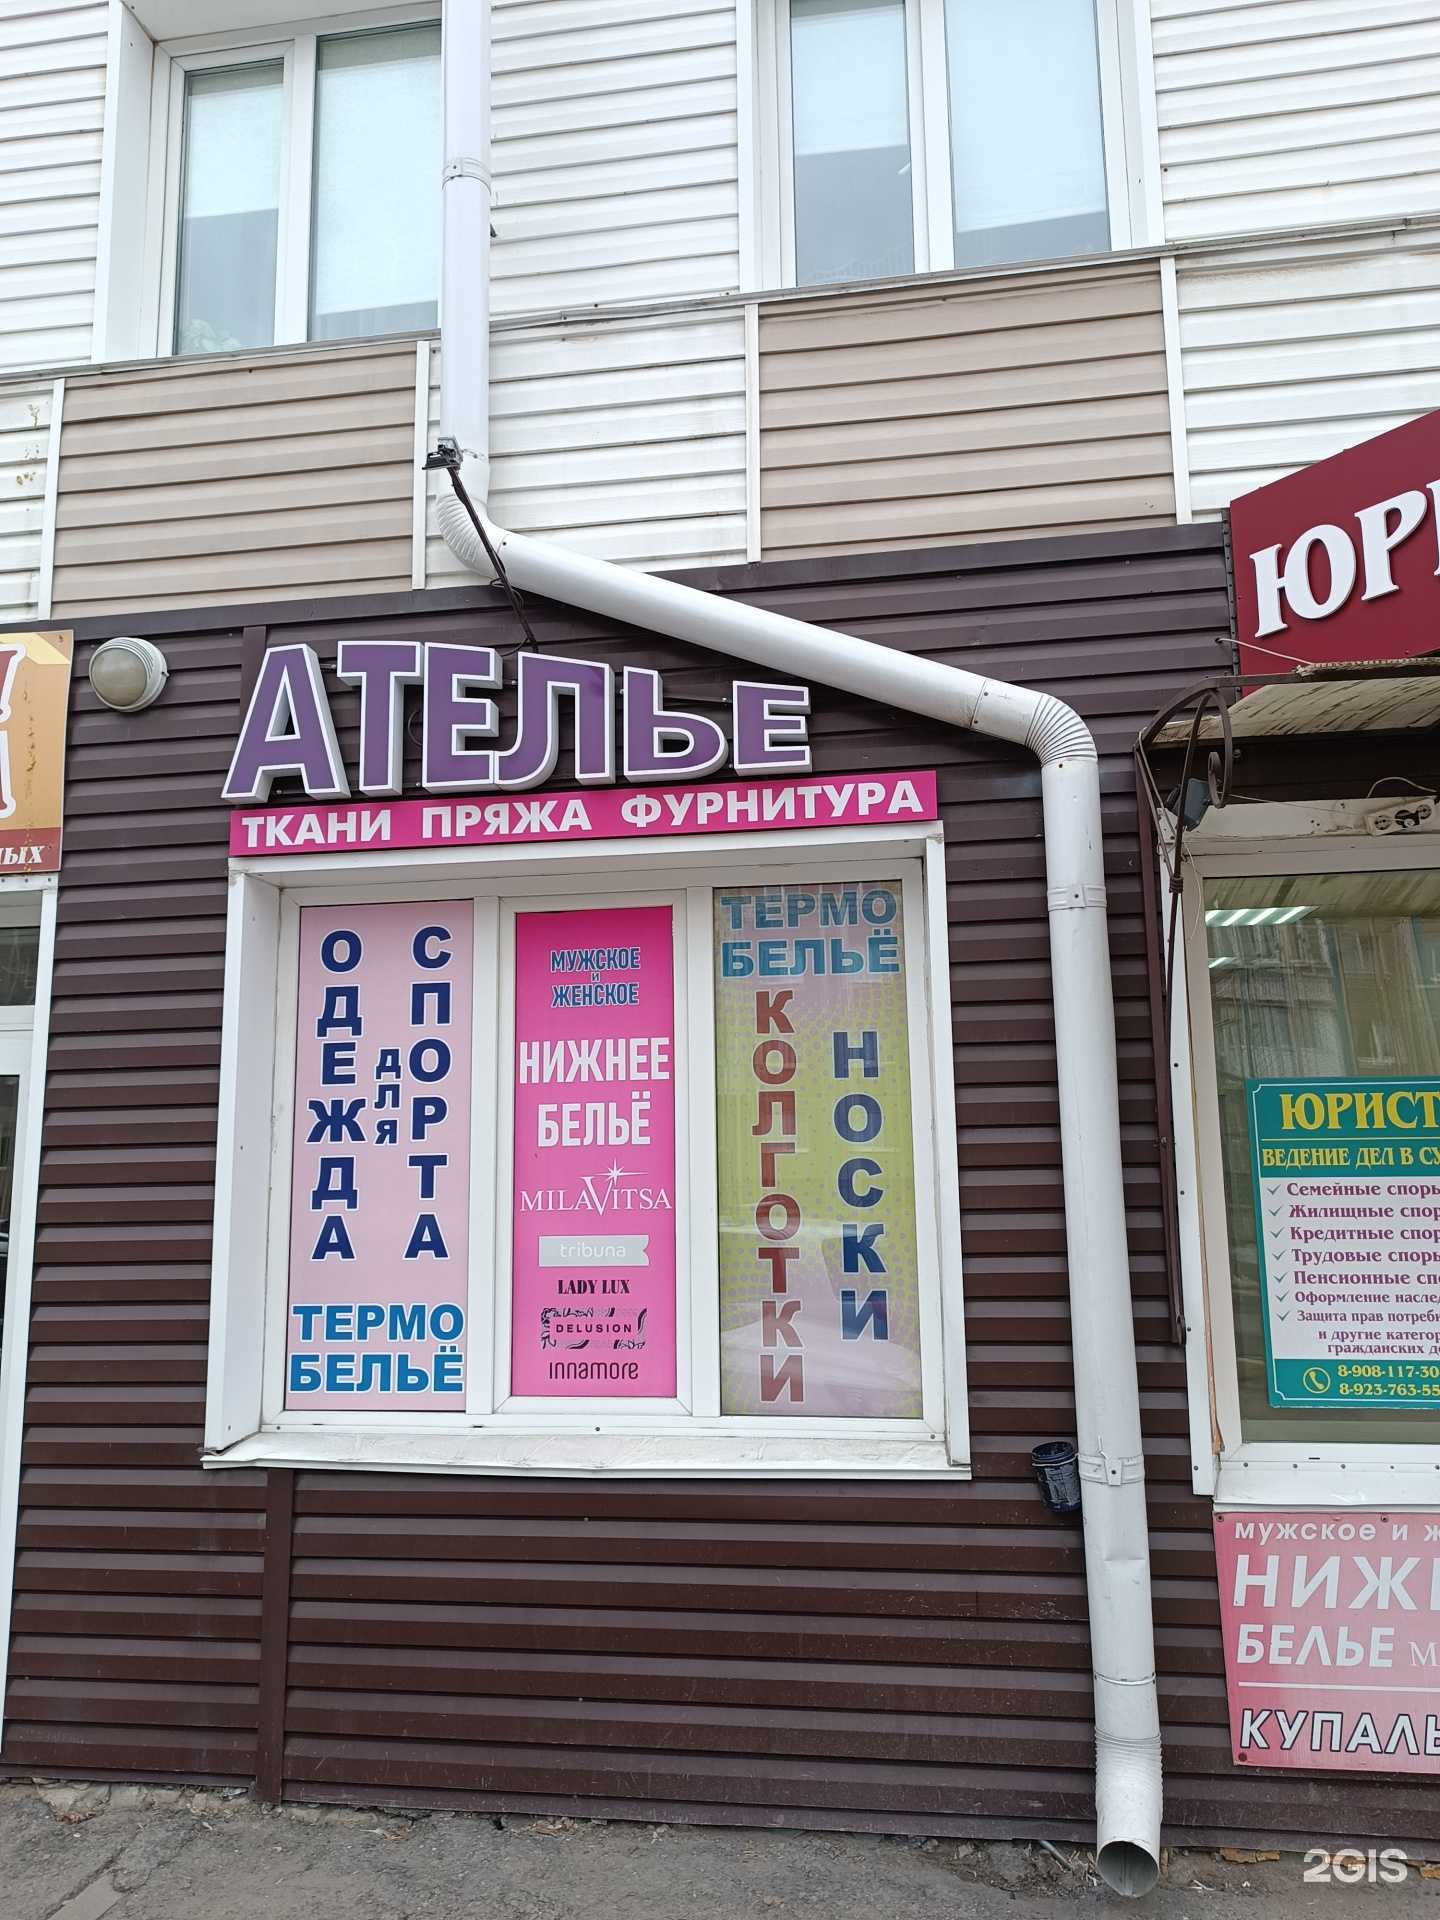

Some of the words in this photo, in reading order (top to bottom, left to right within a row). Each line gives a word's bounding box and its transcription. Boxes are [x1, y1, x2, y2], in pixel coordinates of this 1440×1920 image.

[1249, 479, 1440, 637] ЮР
[221, 640, 812, 804] АТЕЛЬЕ
[241, 809, 392, 848] ТКАНИ
[421, 798, 592, 840] ПРЯЖА
[620, 780, 924, 829] ФУРНИТУРА
[0, 846, 45, 864] ЫХ
[719, 888, 898, 931] ТЕРМО
[551, 947, 640, 972] МУЖСКОЕ
[719, 928, 901, 979] БЕЛЬЁ
[551, 983, 640, 1008] ЖЕНСКОЕ
[519, 1037, 670, 1084] НИЖНЕЕ
[305, 928, 367, 1262] ОДЕЖДА
[402, 925, 454, 1262] СПОРТА
[538, 1090, 651, 1147] БЕЛЬЁ
[1279, 1091, 1440, 1130] ЮРИСТ
[1262, 1147, 1350, 1170] ВЕДЕНИЕ
[1355, 1147, 1395, 1169] ДЕЛ
[1400, 1147, 1414, 1165] В
[751, 989, 806, 1404] КОЛГОТКИ
[832, 1029, 891, 1343] НОСКИ
[1286, 1182, 1381, 1196] Семейные
[1288, 1204, 1394, 1221] Жилищные
[1290, 1226, 1394, 1243] Кредитные
[560, 1241, 626, 1258] tribuna
[1291, 1248, 1382, 1265] Трудовые
[558, 1280, 598, 1295] LADY
[602, 1280, 630, 1294] LUX
[1293, 1270, 1410, 1285] Пенсионные
[1416, 1274, 1440, 1285] сп
[1294, 1291, 1390, 1305] Оформление
[1395, 1294, 1440, 1304] насле
[290, 1303, 465, 1343] ТЕРМО
[556, 1324, 632, 1333] DELUSION
[1296, 1310, 1347, 1324] Защита
[1351, 1312, 1384, 1325] прав
[1318, 1331, 1327, 1340] и
[1331, 1330, 1382, 1343] другие
[1327, 1344, 1424, 1356] гражданских
[289, 1345, 464, 1394] БЕЛЬЁ
[1235, 1520, 1377, 1546] мужское
[1391, 1523, 1409, 1541] и
[1232, 1554, 1440, 1611] НИЖ
[1236, 1623, 1395, 1668] БЕЛЬЕ
